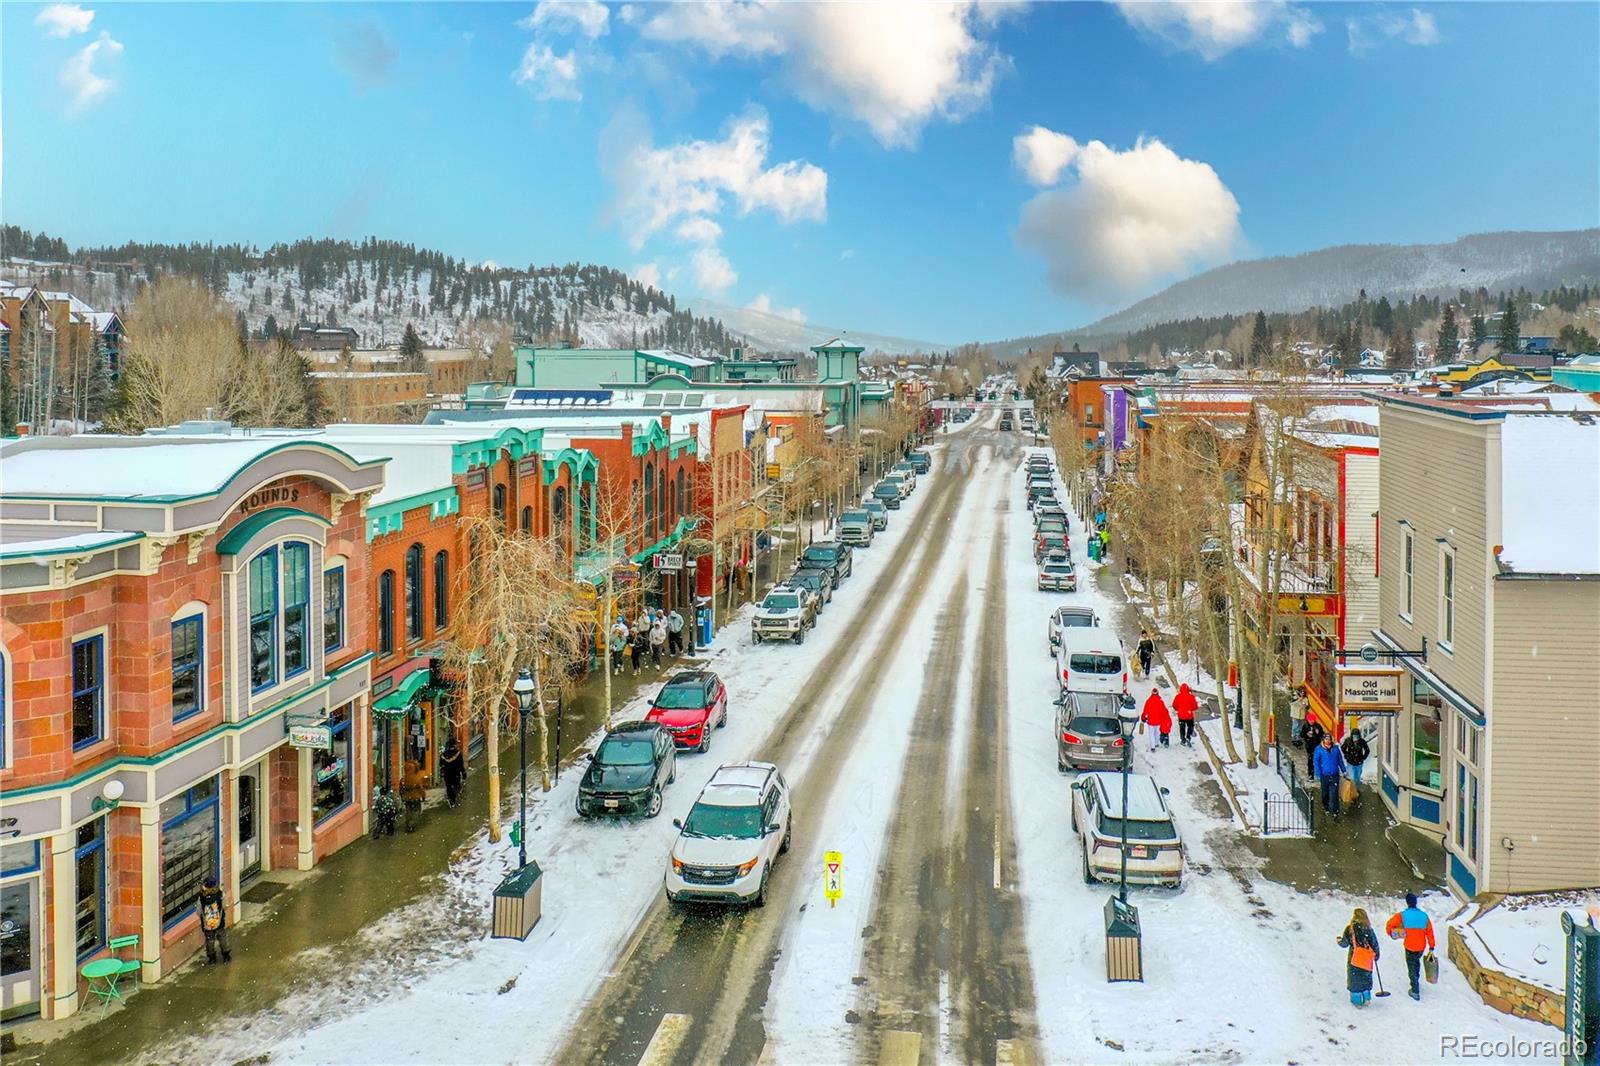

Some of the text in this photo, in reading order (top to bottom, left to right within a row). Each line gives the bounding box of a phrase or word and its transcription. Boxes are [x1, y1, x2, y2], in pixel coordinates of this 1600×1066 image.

[1362, 680, 1378, 688] Old
[1345, 688, 1396, 696] Masonic Hall
[1572, 936, 1584, 1014] DISTRICT
